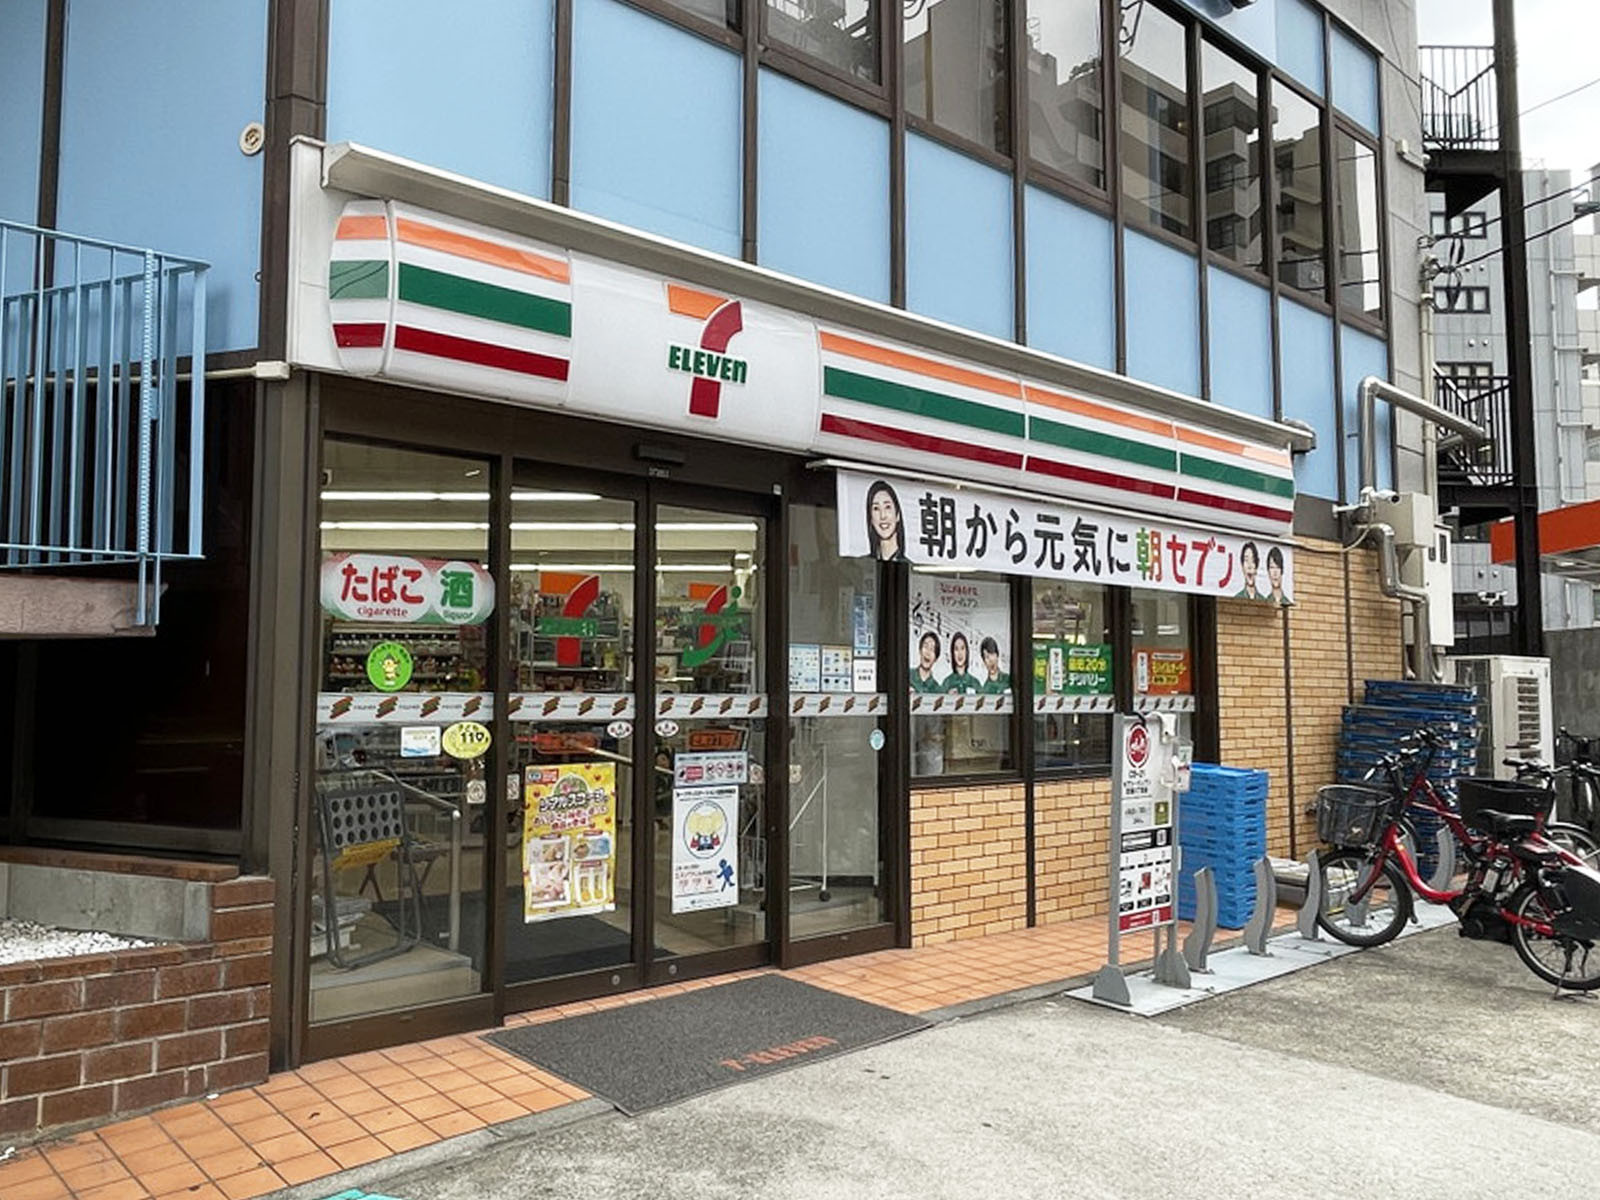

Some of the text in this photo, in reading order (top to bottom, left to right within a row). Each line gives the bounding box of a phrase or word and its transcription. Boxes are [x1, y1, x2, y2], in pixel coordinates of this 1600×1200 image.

[919, 492, 1233, 588] 朝から元気に朝セブン
[341, 563, 425, 604] たばこ
[440, 570, 474, 608] 酒
[357, 606, 408, 617] cigarette
[443, 610, 473, 620] liquor
[1068, 673, 1106, 686] デリバリー
